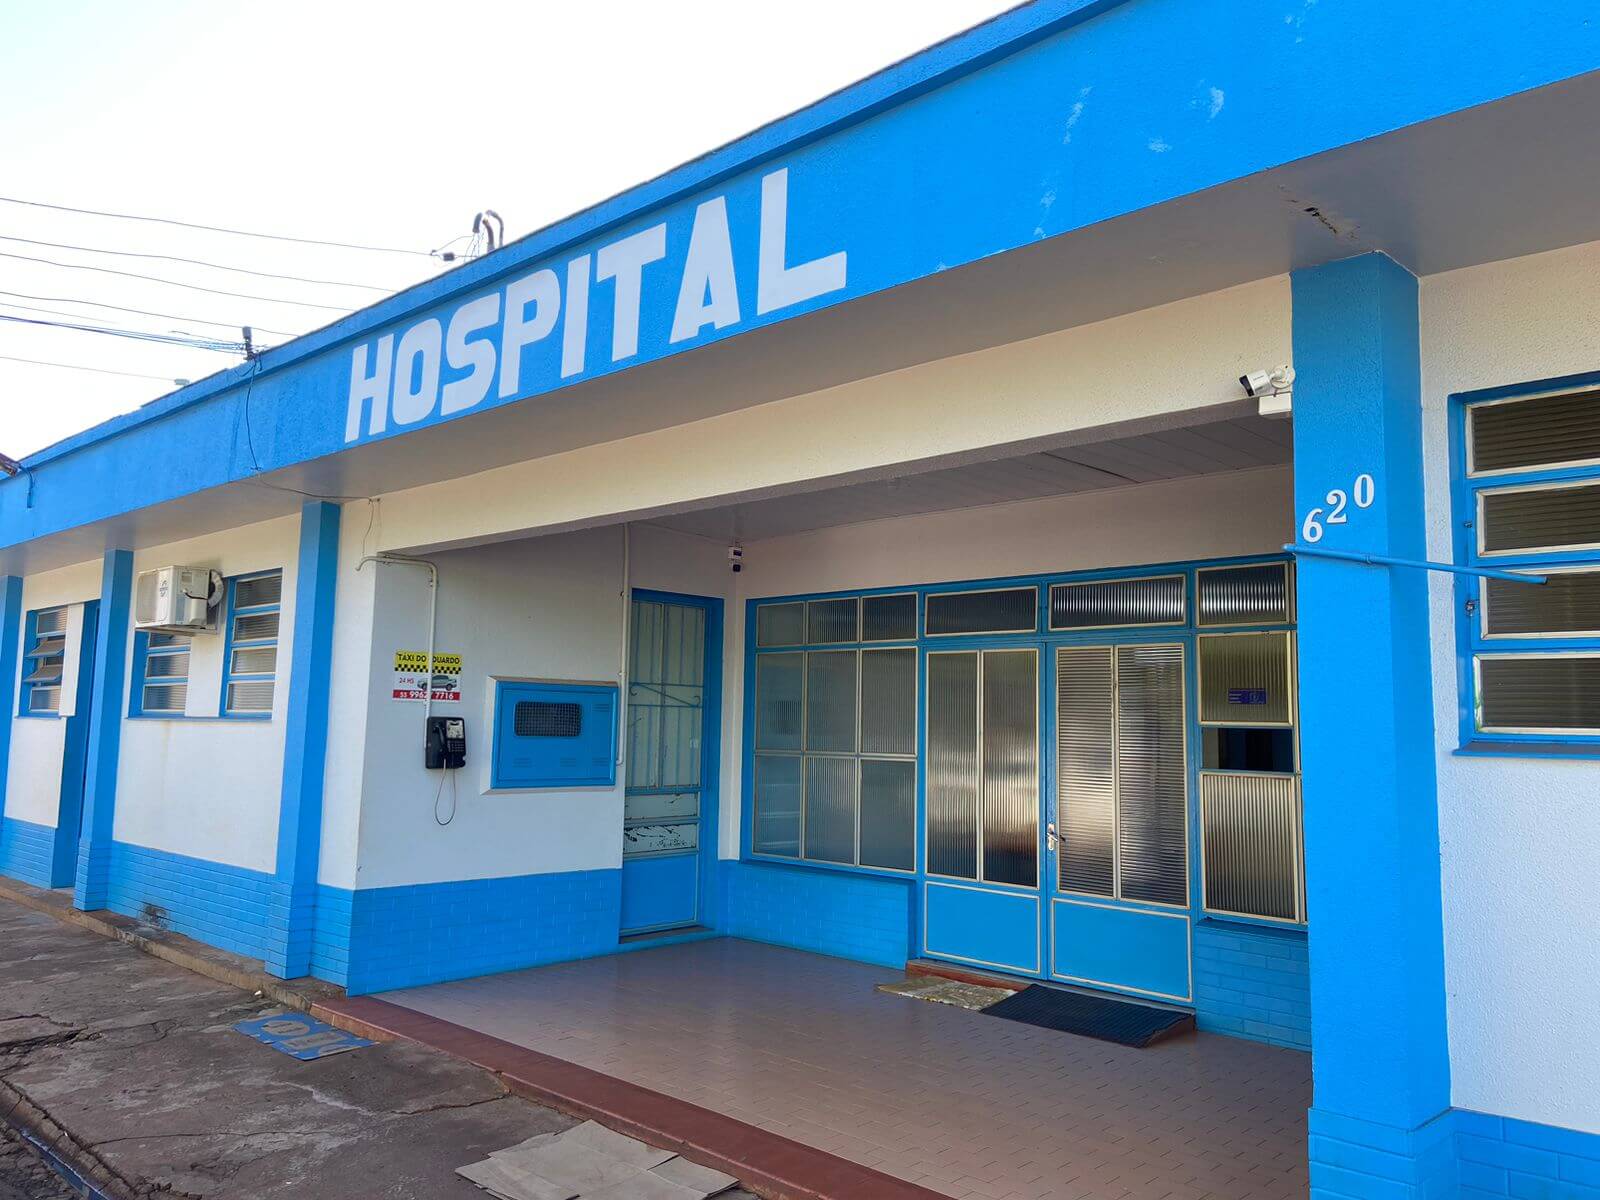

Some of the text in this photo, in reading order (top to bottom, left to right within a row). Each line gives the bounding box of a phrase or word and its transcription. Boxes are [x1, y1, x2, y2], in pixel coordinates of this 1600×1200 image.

[344, 167, 848, 444] HOSPITAL
[1302, 473, 1375, 543] 620
[416, 655, 427, 663] DO
[430, 657, 461, 665] DUARDO
